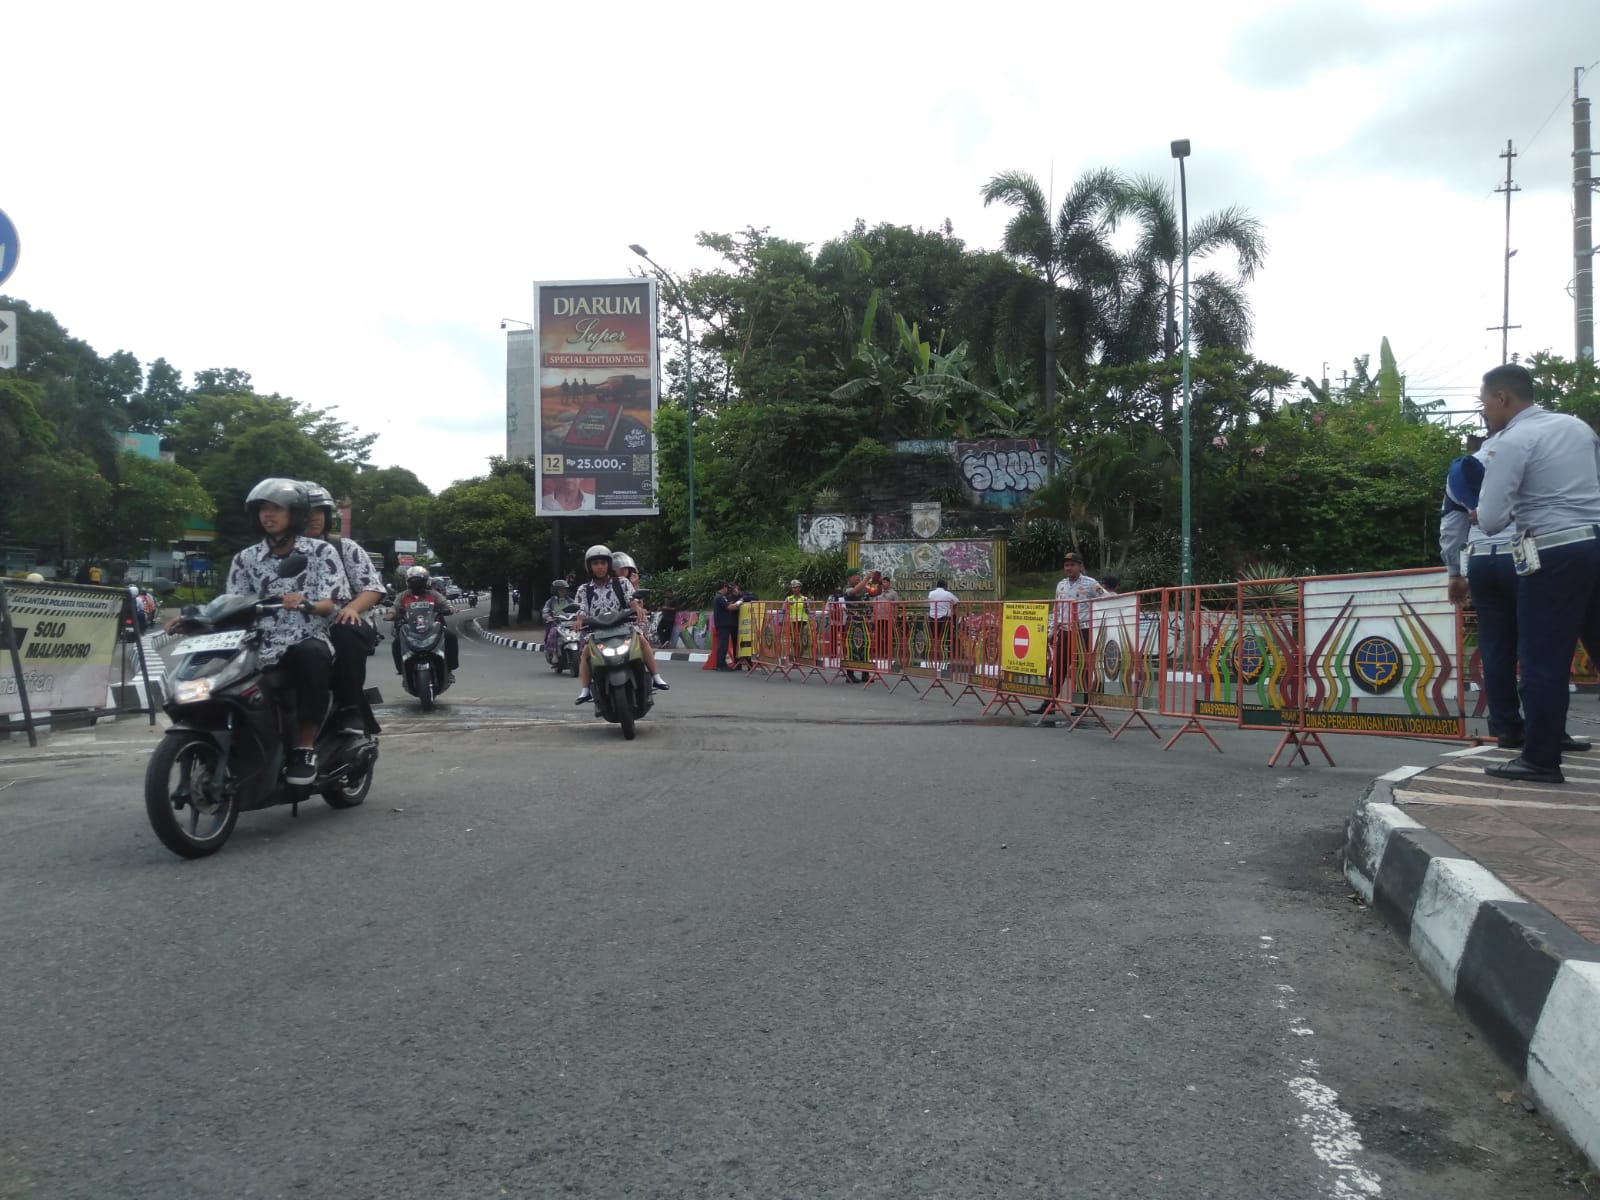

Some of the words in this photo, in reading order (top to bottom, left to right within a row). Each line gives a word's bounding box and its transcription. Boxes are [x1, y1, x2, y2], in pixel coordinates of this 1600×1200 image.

[553, 296, 642, 316] DJARUM
[566, 318, 625, 351] Super
[550, 355, 585, 364] SPECIAL
[586, 355, 621, 364] EDITION
[623, 355, 644, 363] PACK
[546, 457, 560, 468] 12
[566, 459, 576, 467] Rp
[576, 458, 627, 470] 25.000,-
[947, 581, 993, 590] NASIONAL
[34, 621, 66, 638] SOLO
[25, 643, 91, 659] MALIOBORO
[1305, 714, 1326, 727] DINAS
[1327, 715, 1383, 730] PERHUBUNGAN
[1384, 717, 1404, 731] KOTA
[1405, 718, 1459, 734] YOGYAKARTA
